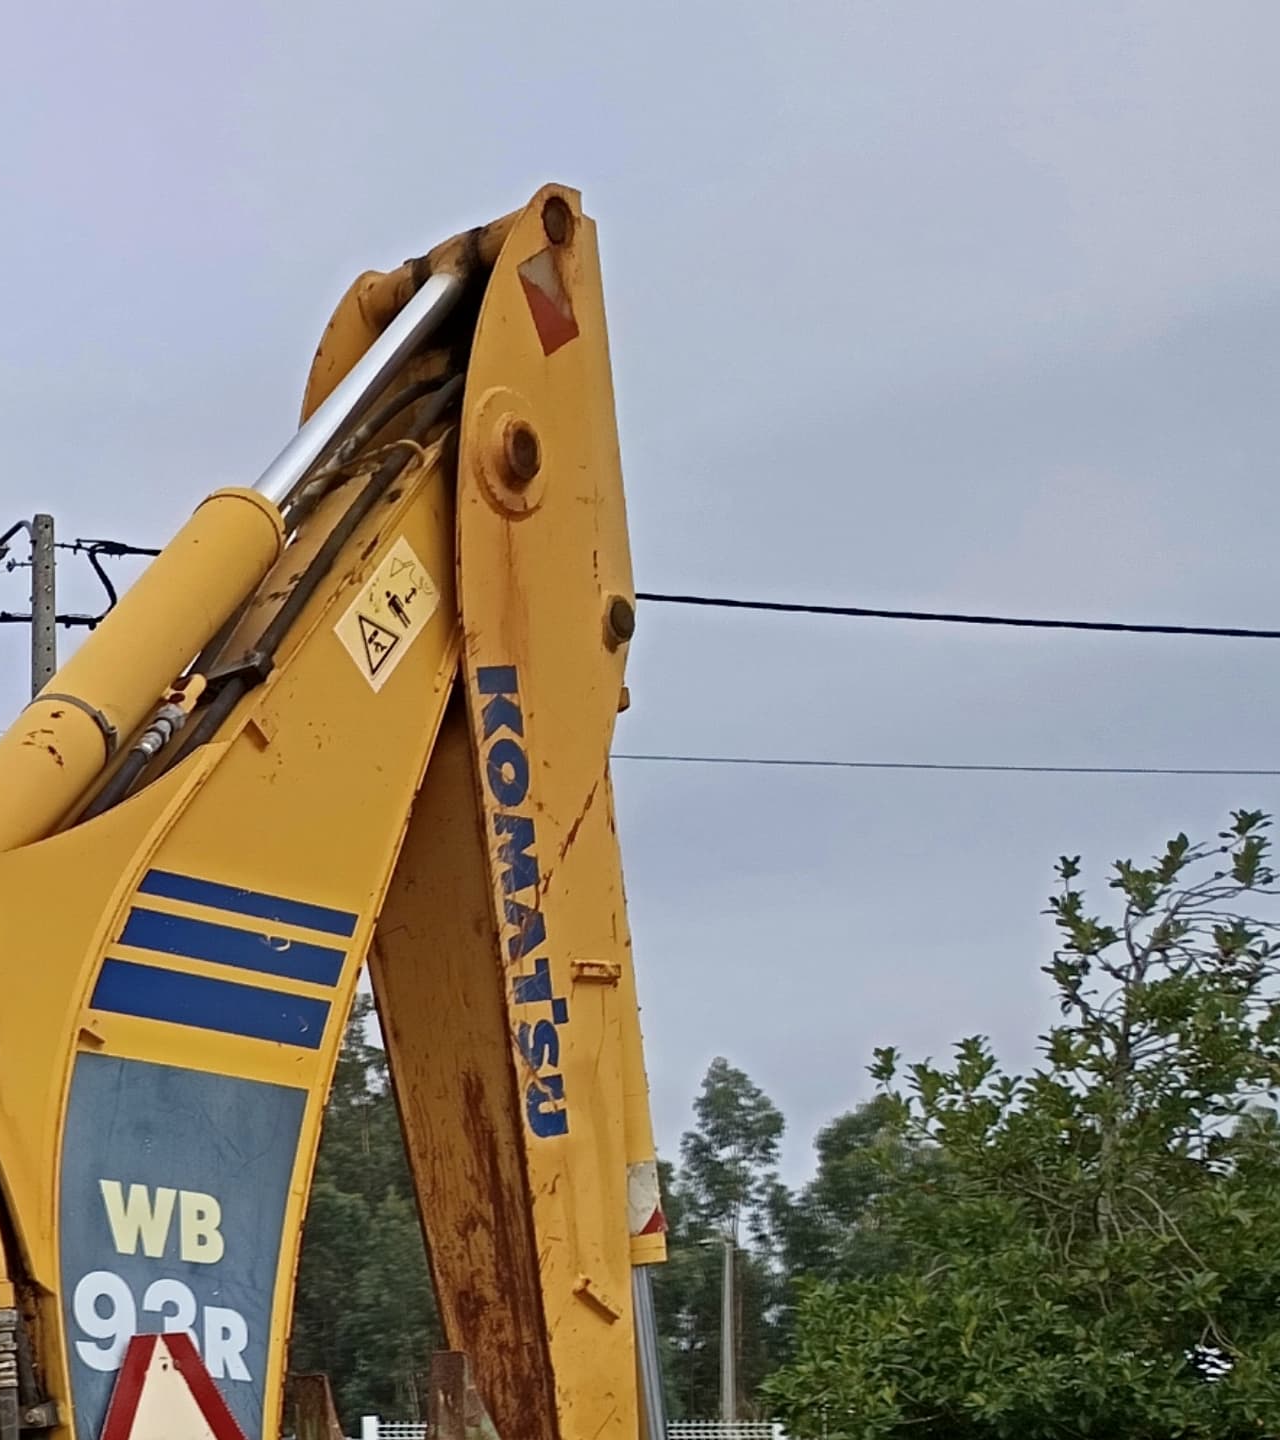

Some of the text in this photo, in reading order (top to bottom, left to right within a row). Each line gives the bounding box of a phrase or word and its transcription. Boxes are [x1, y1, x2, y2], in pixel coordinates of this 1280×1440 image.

[476, 665, 570, 1139] KOMATSU
[99, 1178, 225, 1265] WB
[73, 1270, 253, 1382] 93R
